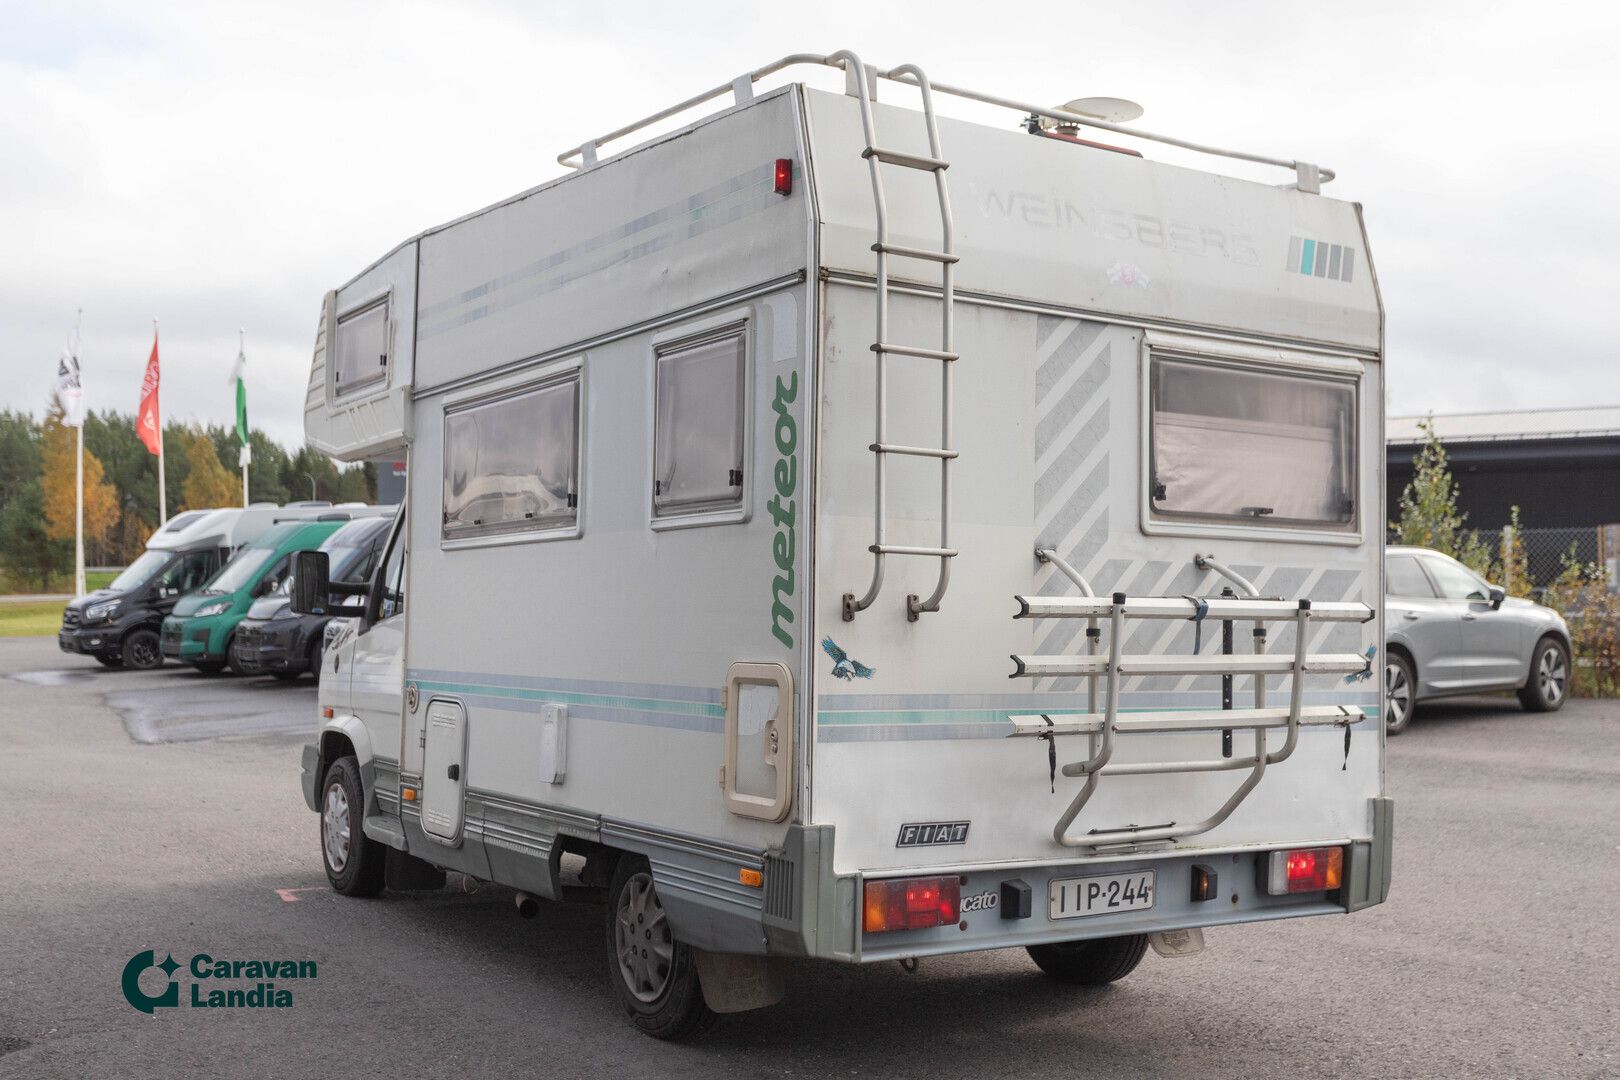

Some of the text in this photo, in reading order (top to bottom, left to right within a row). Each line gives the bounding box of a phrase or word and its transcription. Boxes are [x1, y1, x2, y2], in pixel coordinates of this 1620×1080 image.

[767, 370, 798, 649] meteor
[903, 824, 968, 844] FIAT
[1060, 876, 1149, 913] IIP-244
